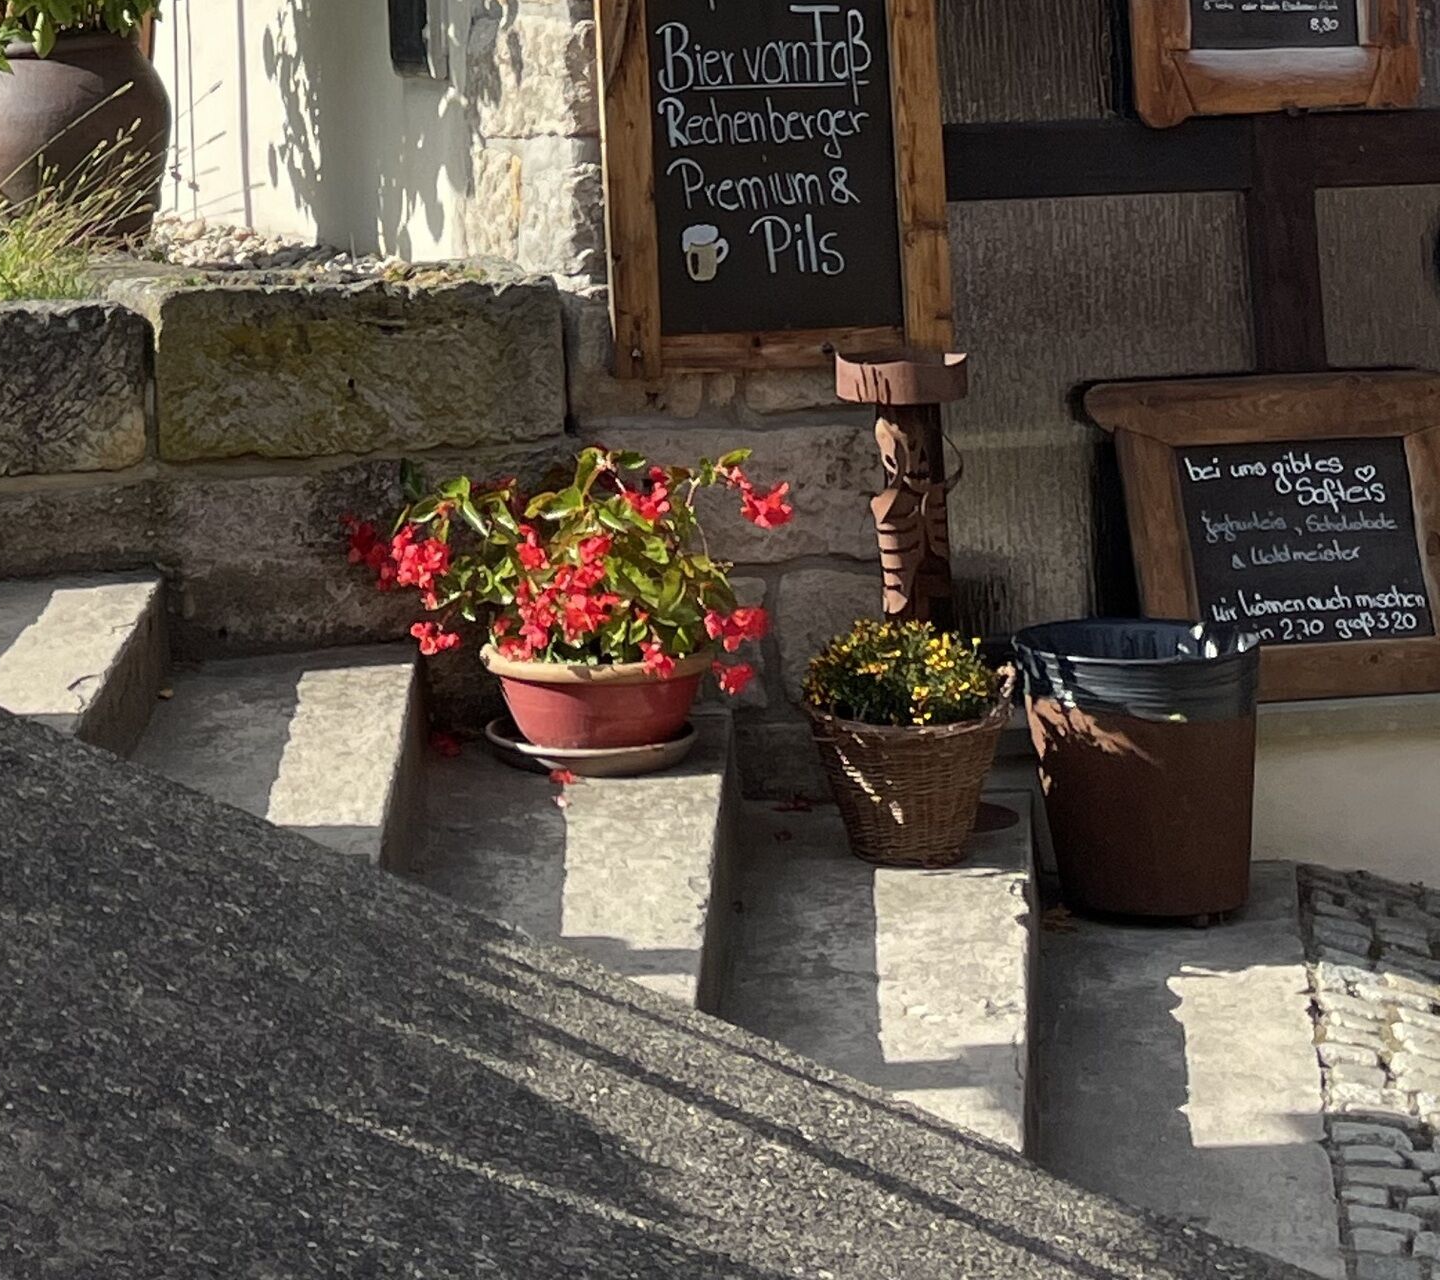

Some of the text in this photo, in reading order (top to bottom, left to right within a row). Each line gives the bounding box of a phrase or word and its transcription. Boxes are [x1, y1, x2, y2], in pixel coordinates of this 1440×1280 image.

[656, 21, 735, 94] Bier
[743, 41, 810, 85] vom
[657, 96, 870, 159] Rechenberger
[666, 154, 861, 211] Premium &
[748, 213, 846, 276] Pils
[1184, 451, 1344, 494] bei uns gibt es
[1295, 476, 1387, 514] Softeis
[1305, 510, 1398, 533] Schokolade
[1250, 539, 1361, 565] Waldmeister
[1306, 584, 1352, 612] auch
[1355, 584, 1426, 609] mischen
